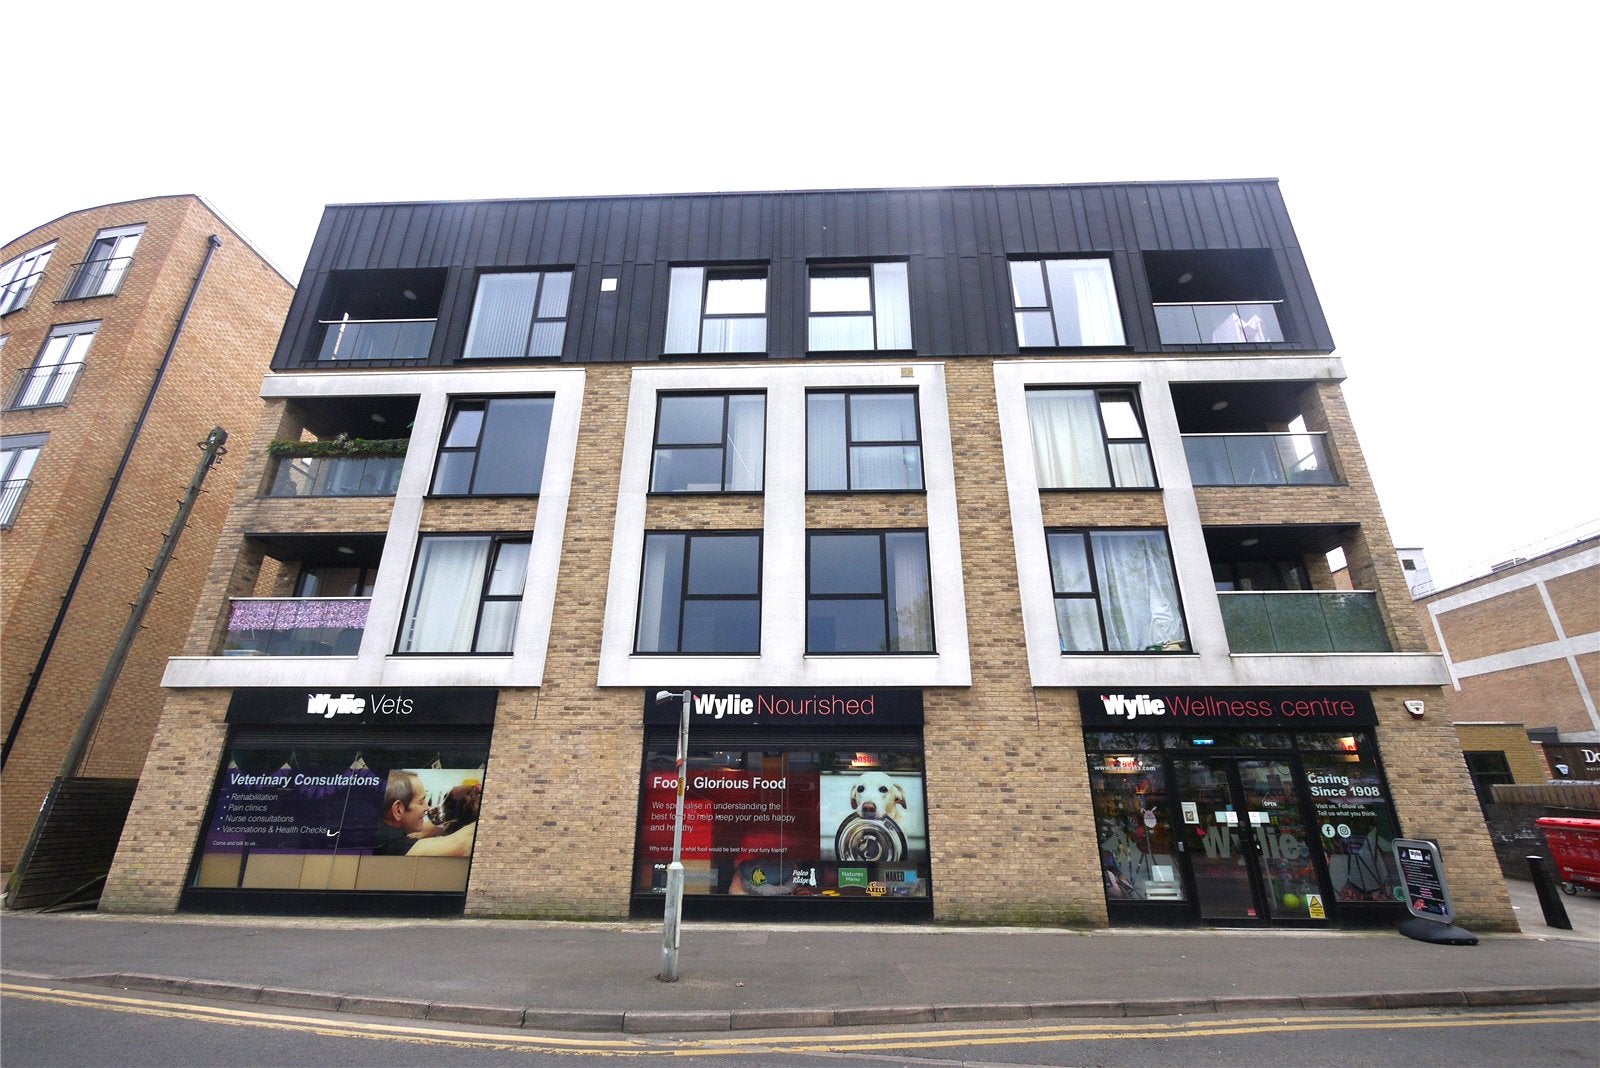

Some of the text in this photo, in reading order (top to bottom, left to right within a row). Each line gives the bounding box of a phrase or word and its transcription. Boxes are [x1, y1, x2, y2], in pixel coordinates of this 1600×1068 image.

[307, 694, 414, 718] Wylie Vets
[693, 694, 875, 719] Wylie Nourished
[1100, 694, 1355, 720] Wylie Wellness centre
[230, 773, 380, 788] Veterinary Consultations
[653, 776, 690, 790] Foo,
[694, 776, 749, 789] Glorious
[753, 777, 787, 789] Food
[1307, 773, 1350, 786] Caring
[231, 792, 279, 801] Rehabilitation
[1311, 786, 1380, 796] Since 1908
[228, 803, 244, 811] Pain
[651, 801, 781, 812] We spialise in understanding the
[225, 814, 295, 823] Nurse consultations
[697, 813, 714, 822] help
[715, 813, 734, 822] keep
[735, 815, 752, 823] your
[753, 814, 770, 823] pets
[771, 814, 796, 823] happy
[222, 825, 267, 833] Vaccinations
[300, 826, 328, 834] Checks
[792, 876, 809, 885] Ridge
[885, 871, 905, 882] NAKED
